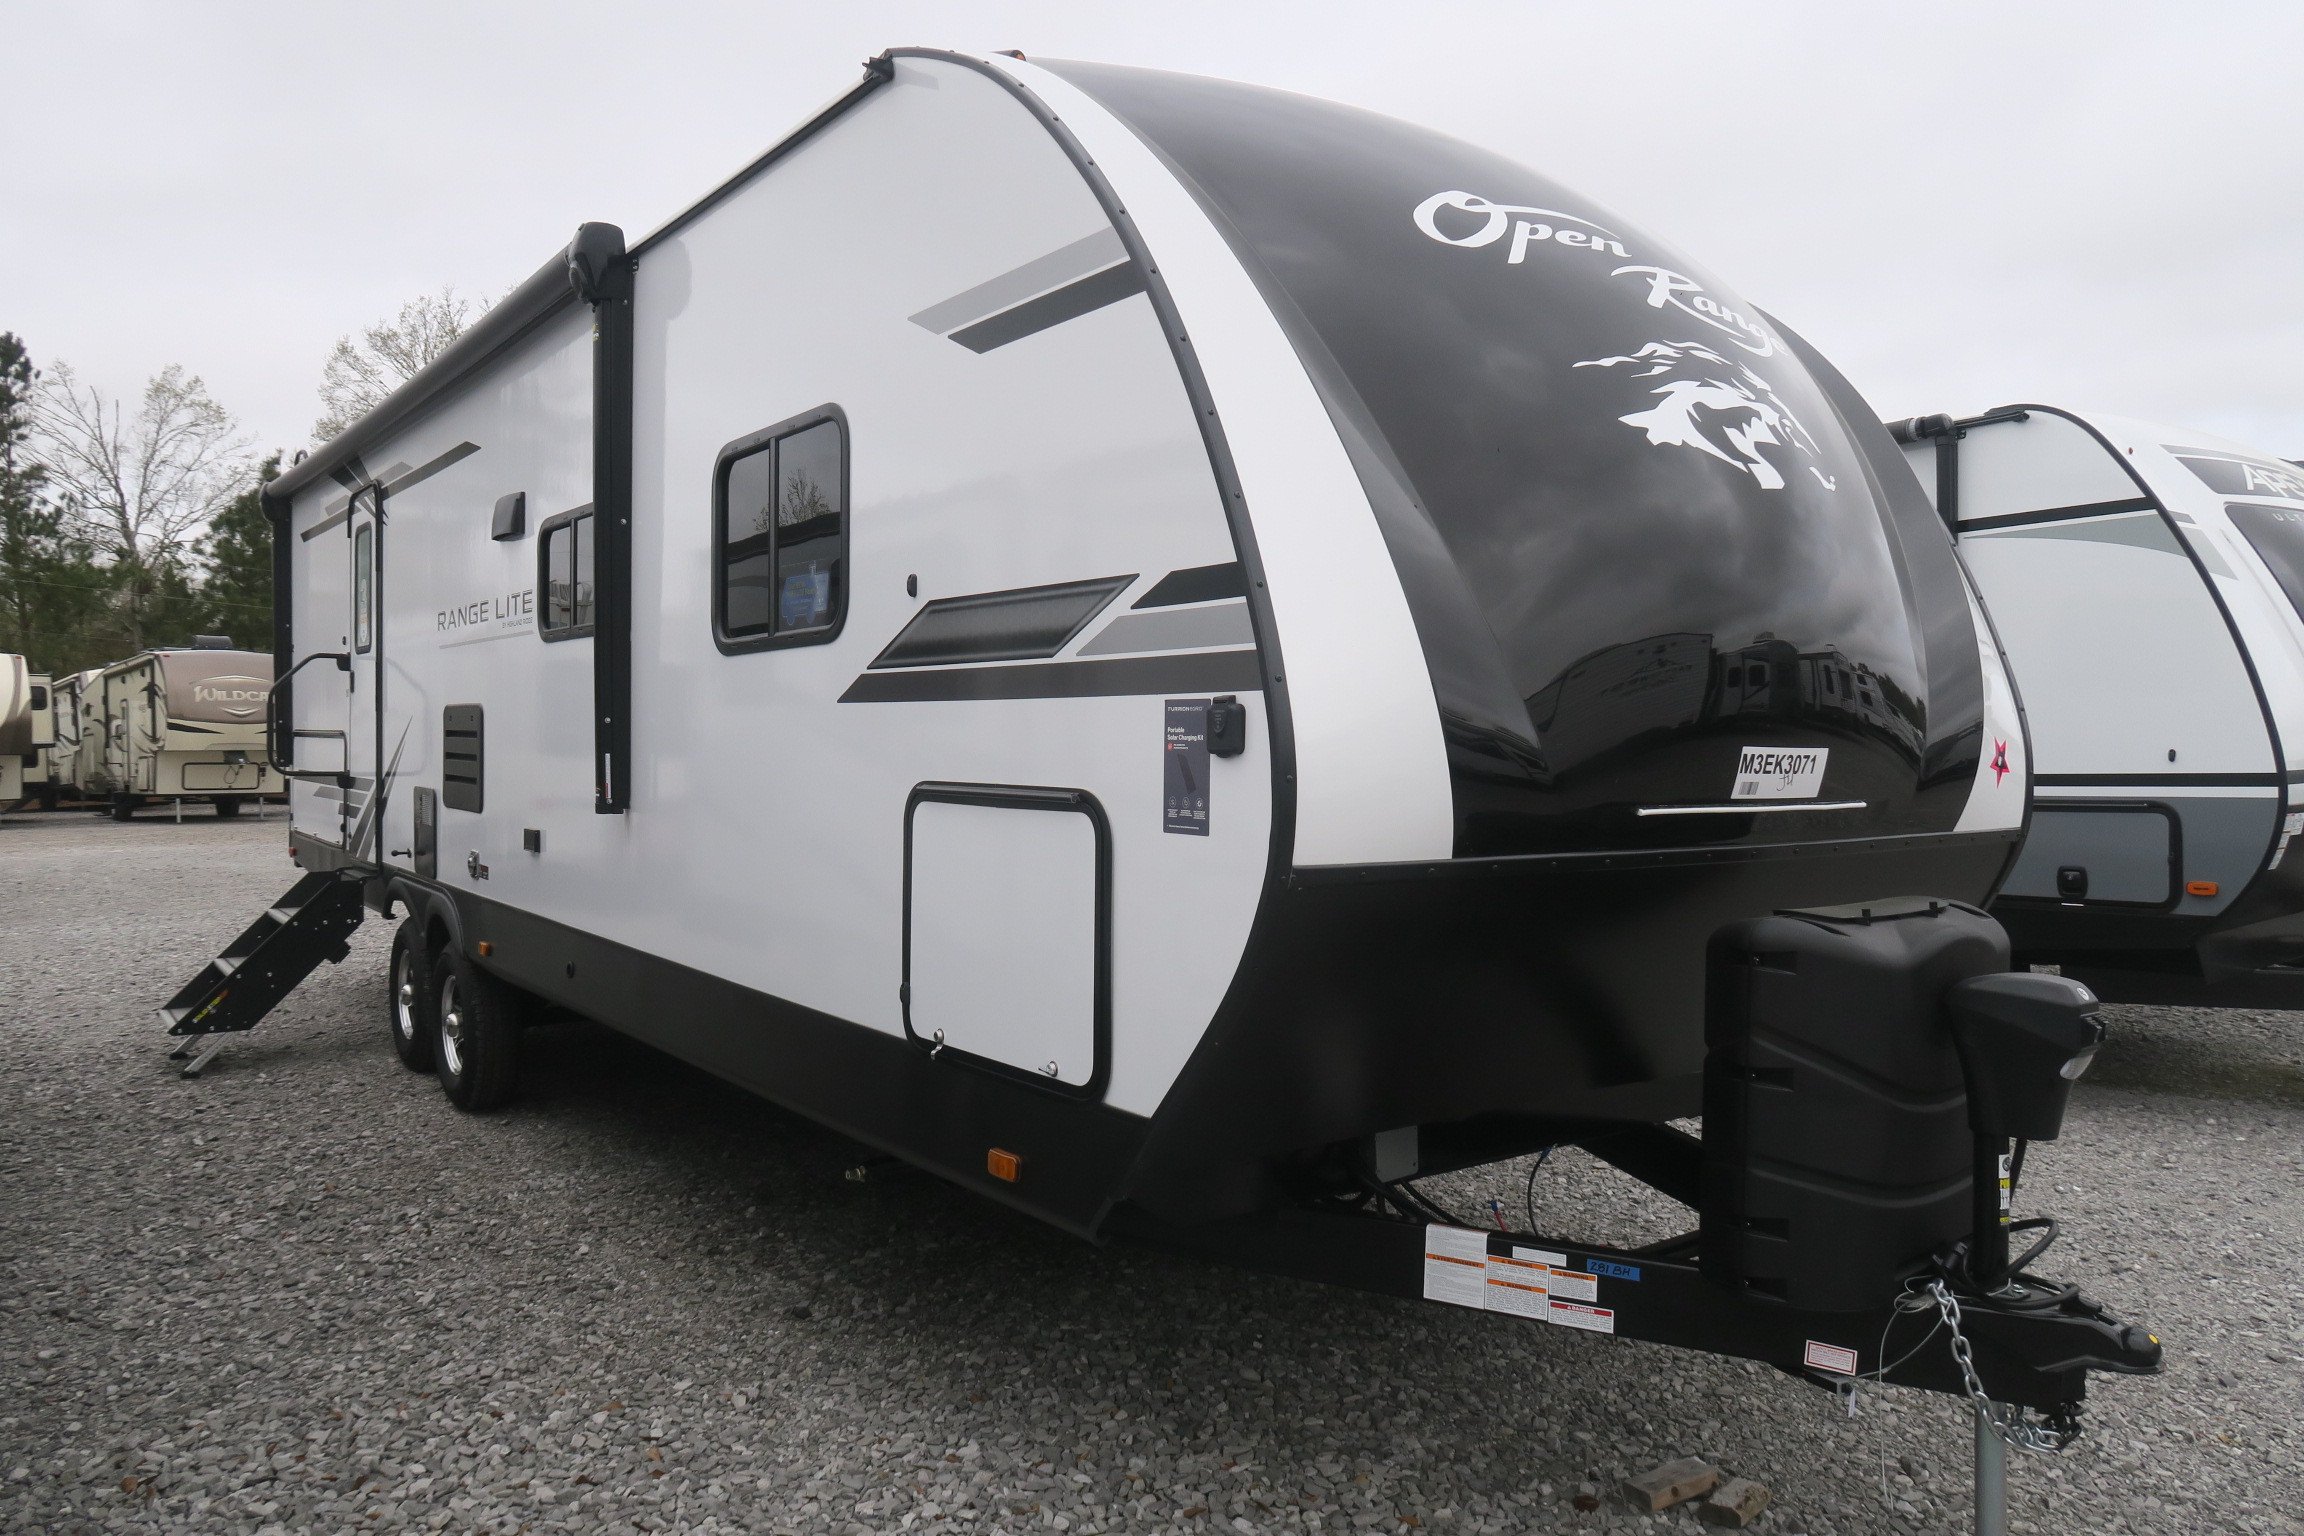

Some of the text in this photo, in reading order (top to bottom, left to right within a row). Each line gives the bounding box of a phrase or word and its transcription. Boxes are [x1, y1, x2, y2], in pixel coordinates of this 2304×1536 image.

[1413, 190, 1632, 264] Open
[1611, 265, 1788, 357] Range
[437, 589, 533, 632] RANGE LITE
[1739, 753, 1817, 775] M3EK3071
[1590, 1261, 1631, 1276] 281 BH
[1572, 1306, 1595, 1315] DANGER
